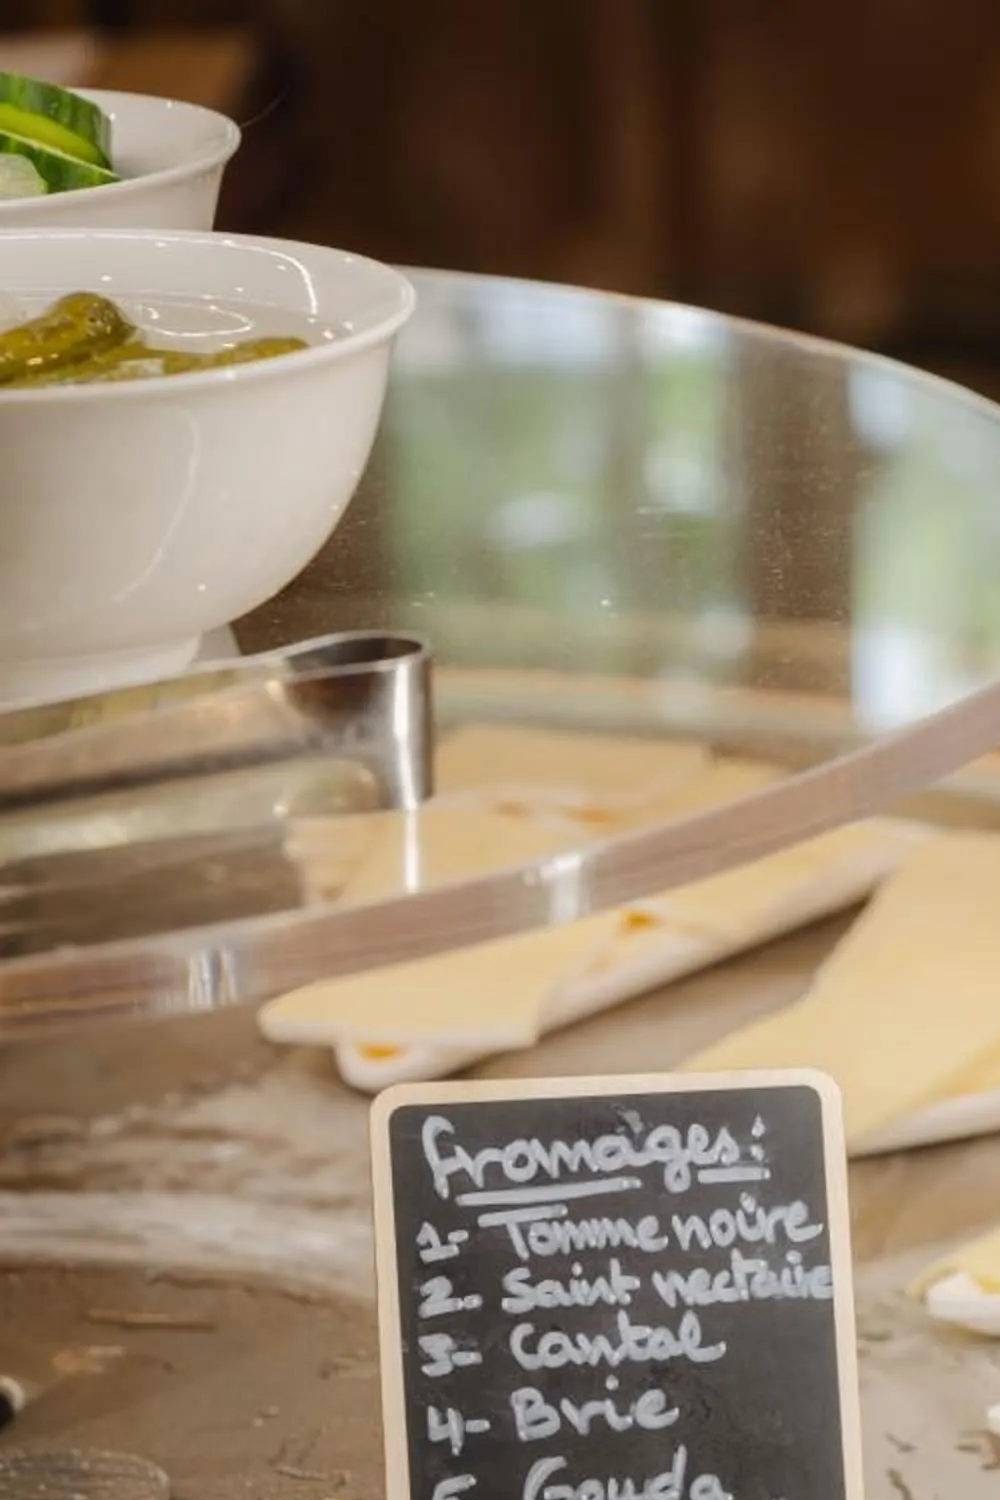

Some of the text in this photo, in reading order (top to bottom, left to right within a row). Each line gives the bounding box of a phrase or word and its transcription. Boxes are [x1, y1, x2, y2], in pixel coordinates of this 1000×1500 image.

[477, 1204, 668, 1260] Tomme
[671, 1191, 824, 1252] noire
[501, 1257, 642, 1314] Saint
[509, 1309, 727, 1370] Cantal
[511, 1374, 681, 1441] Brie
